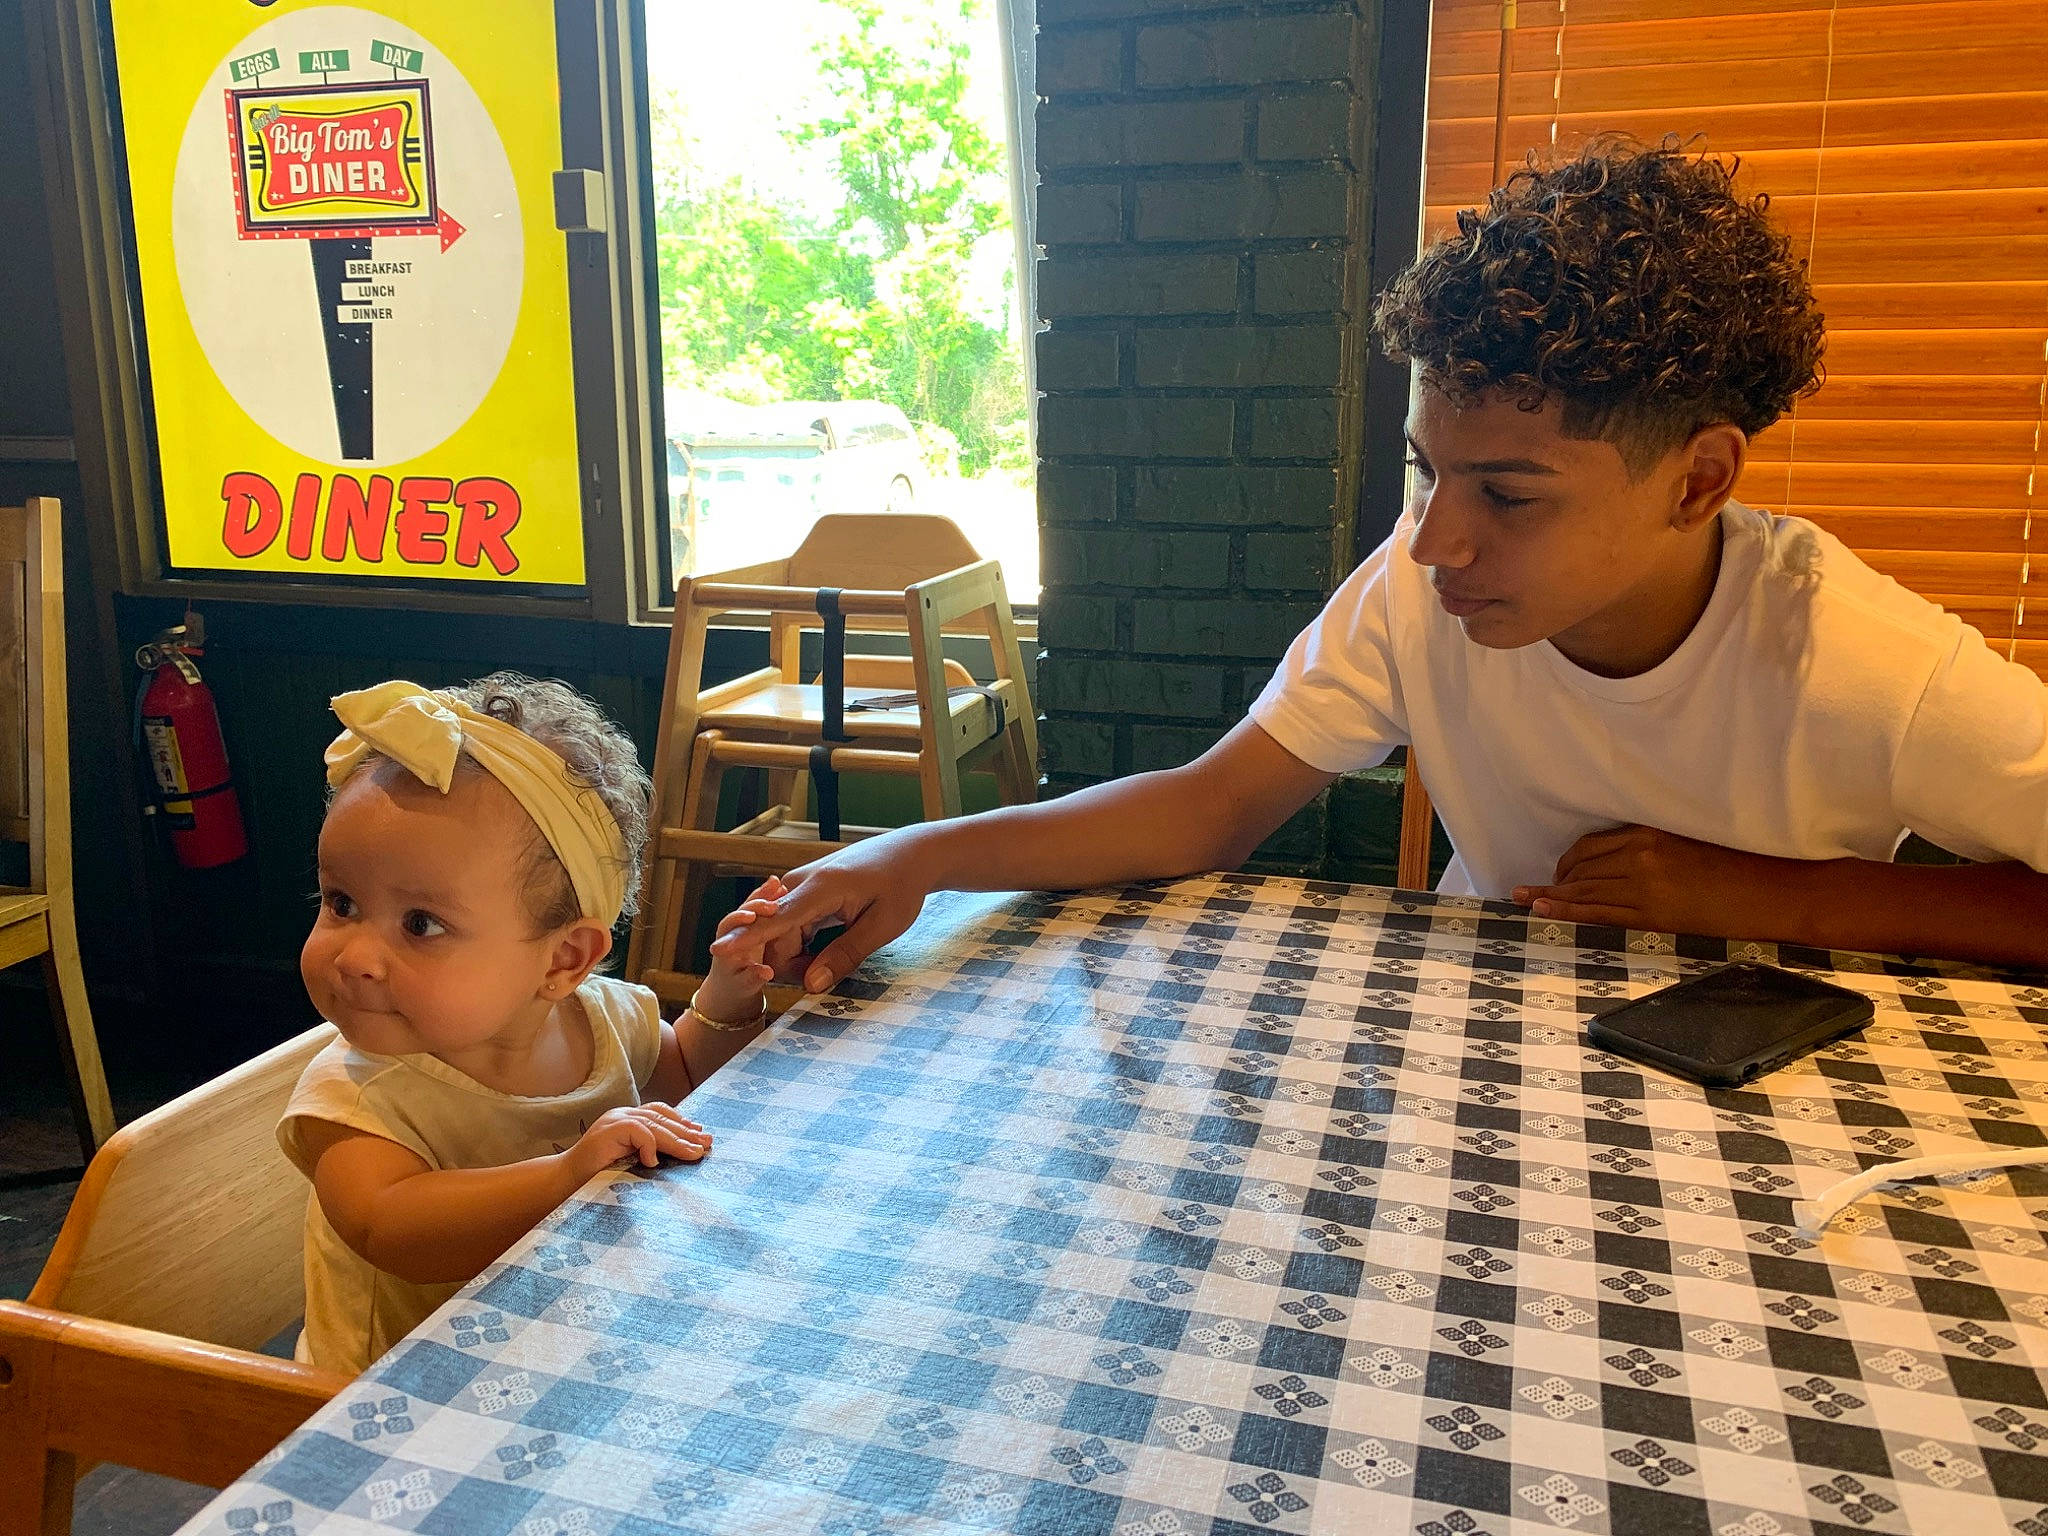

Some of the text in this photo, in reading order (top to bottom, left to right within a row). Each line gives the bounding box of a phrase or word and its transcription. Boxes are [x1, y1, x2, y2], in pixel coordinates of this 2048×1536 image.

[237, 45, 411, 78] EGGS ALL DAY
[269, 123, 317, 162] Big
[317, 118, 394, 153] Tom's
[288, 160, 386, 194] DINER
[349, 262, 412, 274] BREAKFAST
[358, 285, 395, 297] LUNCH
[352, 308, 393, 319] DINNER
[221, 471, 522, 576] DINER
